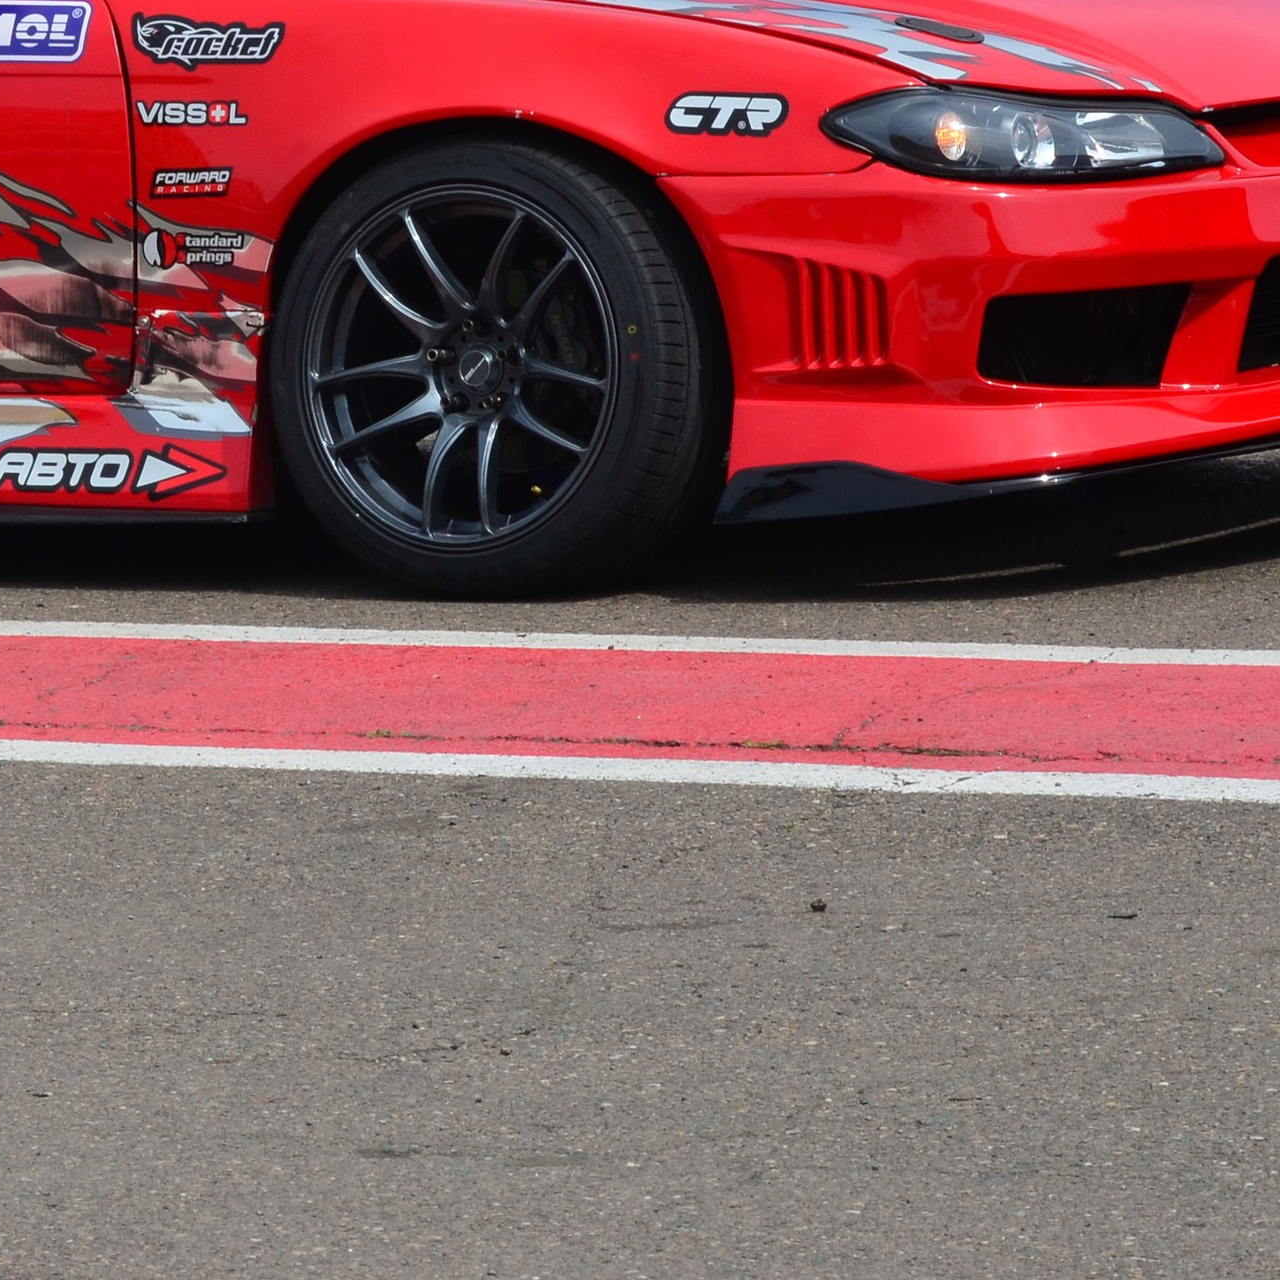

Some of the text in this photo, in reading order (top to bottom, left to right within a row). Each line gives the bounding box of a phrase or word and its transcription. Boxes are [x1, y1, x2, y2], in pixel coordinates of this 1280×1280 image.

[669, 95, 783, 131] CTR
[155, 170, 230, 184] FORWARD
[157, 184, 224, 193] RACING
[176, 232, 242, 248] Standard
[176, 249, 233, 265] Springs
